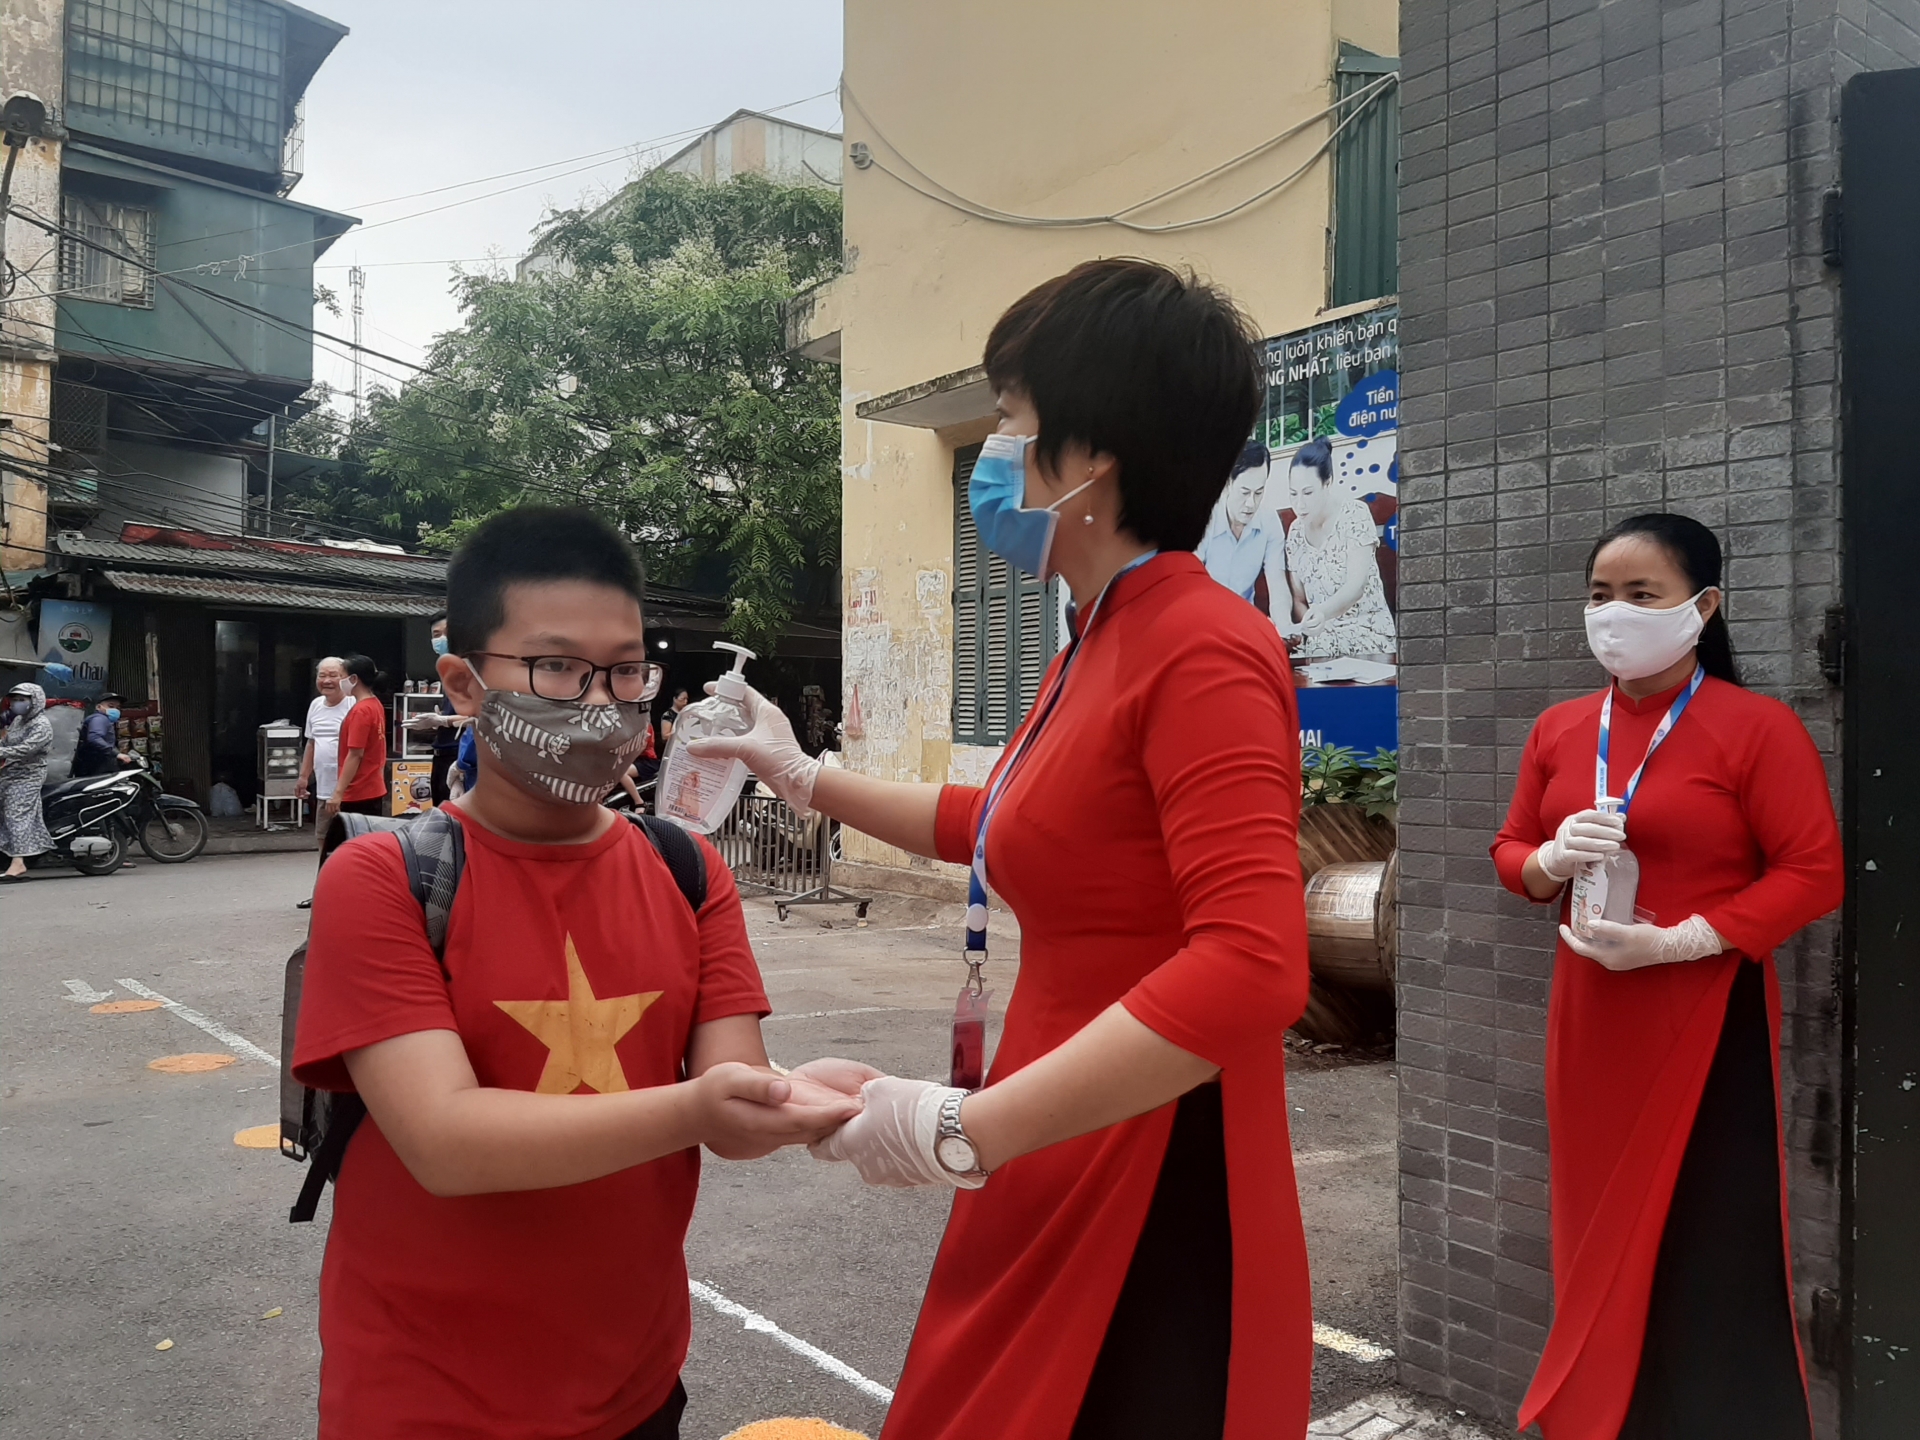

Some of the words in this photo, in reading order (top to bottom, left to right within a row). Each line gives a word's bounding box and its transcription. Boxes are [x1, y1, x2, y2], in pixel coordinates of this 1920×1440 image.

[1286, 340, 1313, 361] luôn
[1317, 325, 1354, 352] khiến
[1358, 322, 1384, 341] bạn
[1264, 368, 1285, 387] NG
[1289, 353, 1332, 383] NHẤT,
[1336, 351, 1361, 371] liệu
[1364, 345, 1391, 364] bạn
[1366, 385, 1394, 406] Tiền
[1348, 409, 1377, 428] điện
